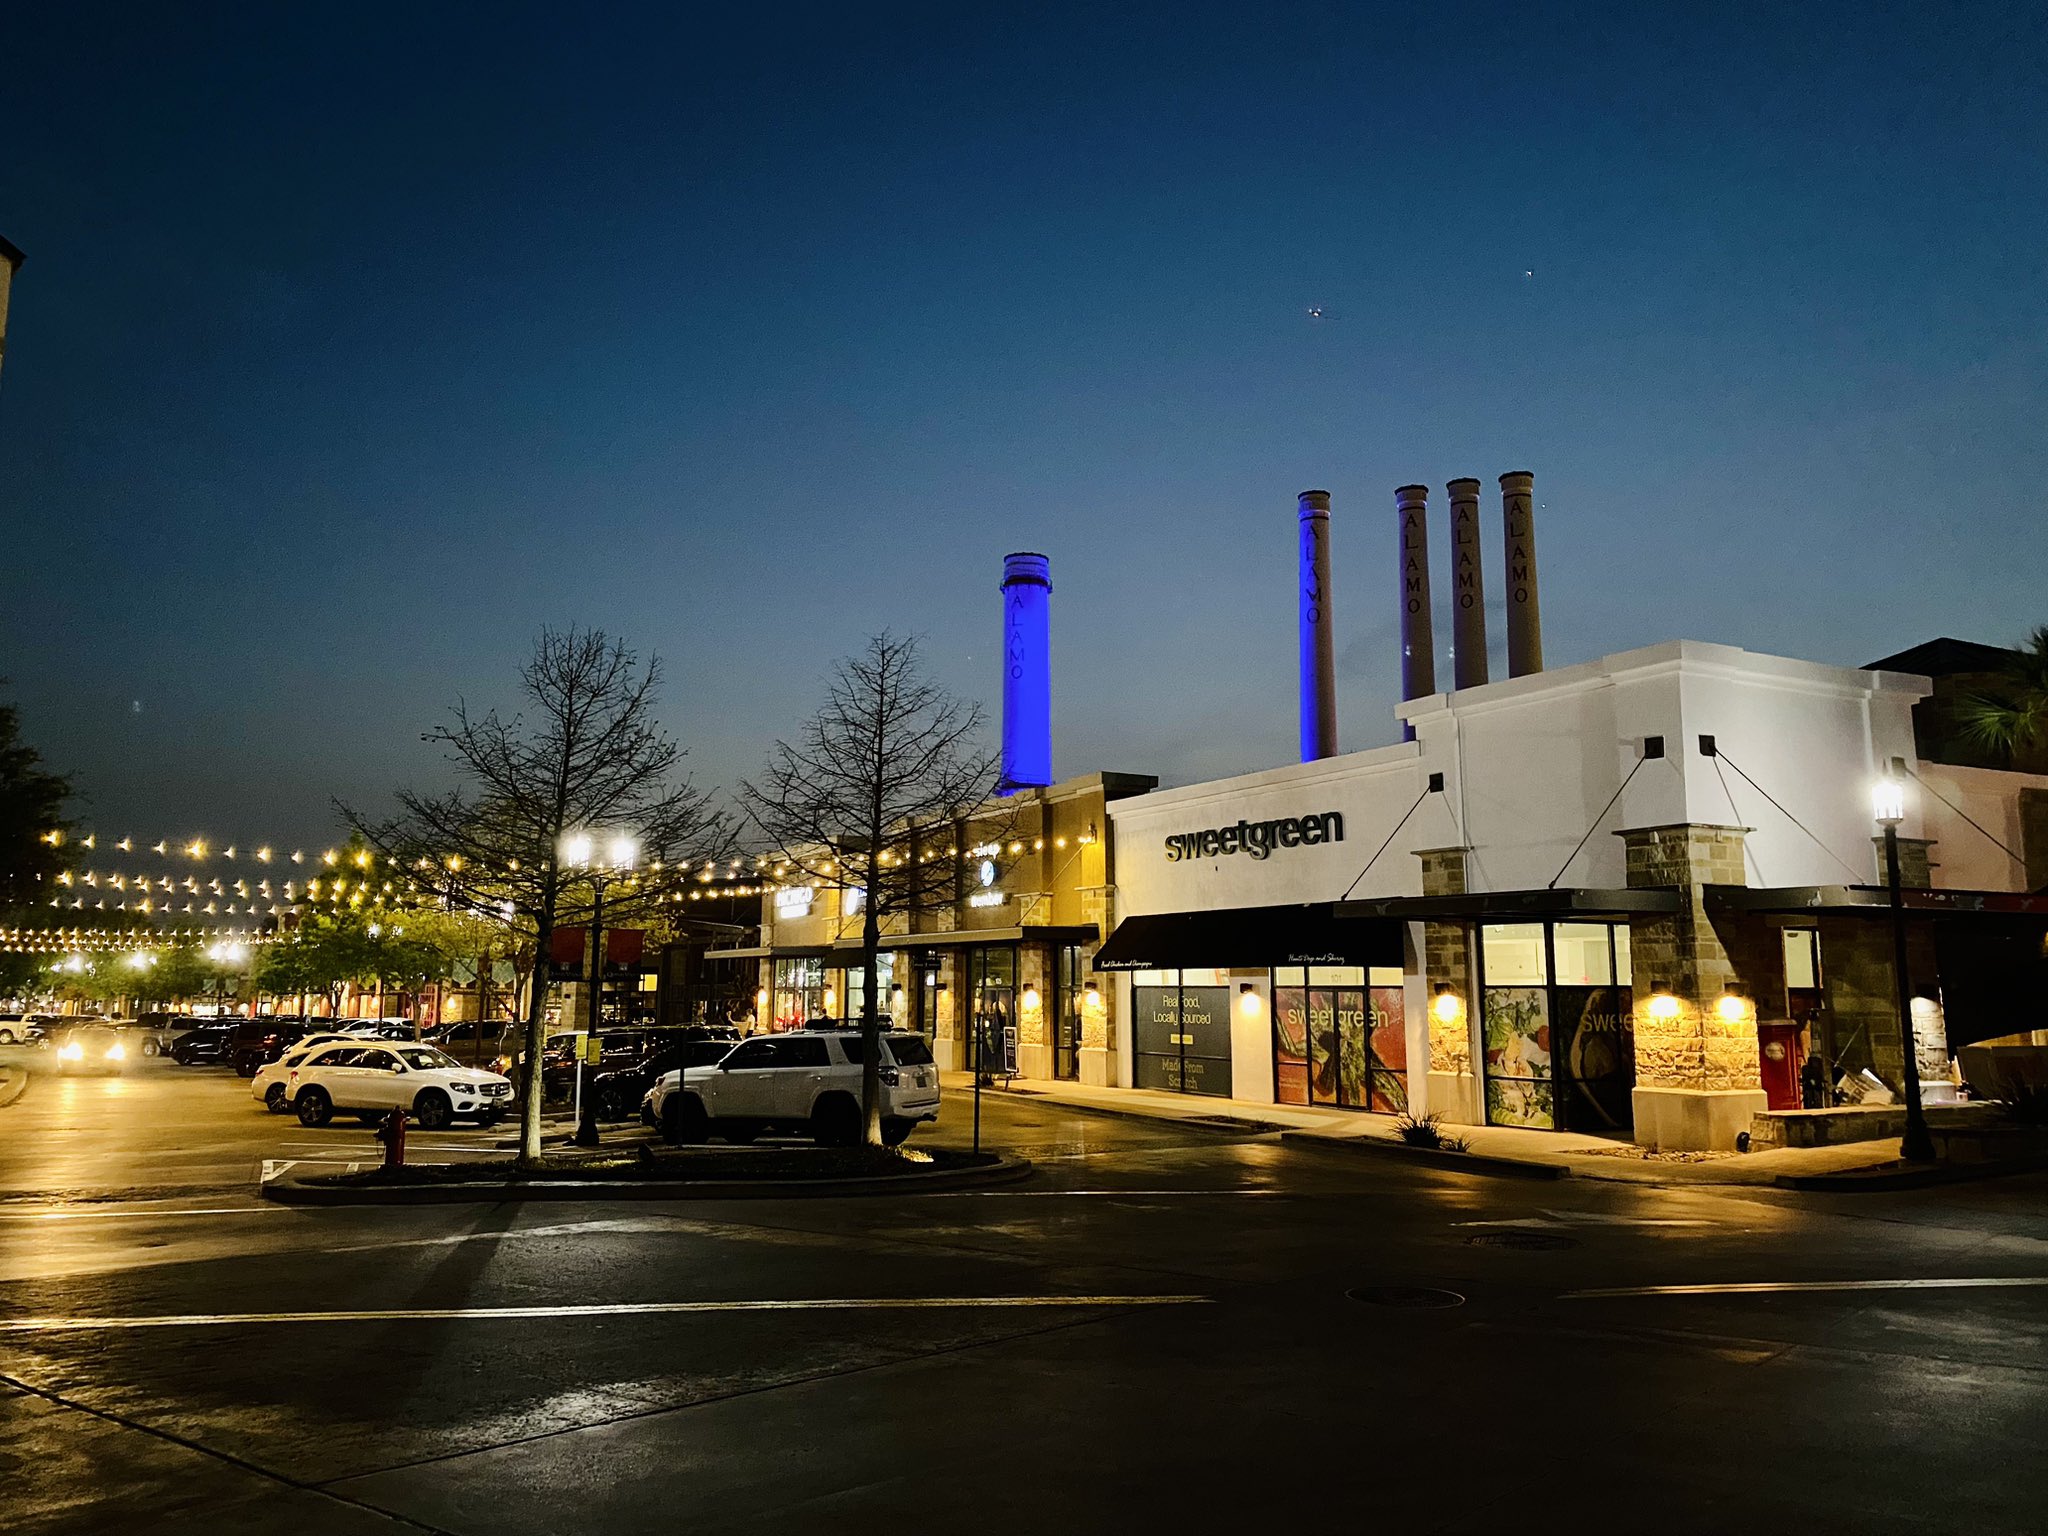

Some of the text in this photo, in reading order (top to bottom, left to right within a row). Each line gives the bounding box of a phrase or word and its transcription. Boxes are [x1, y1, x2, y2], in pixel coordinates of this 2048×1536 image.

[1305, 524, 1322, 624] ALAMO
[1405, 513, 1421, 614] ALAMO
[1456, 507, 1475, 609] ALAMO
[1510, 500, 1528, 603] ALAMO
[1009, 594, 1025, 680] ALAMO
[1165, 811, 1346, 863] sweetgreen
[1153, 1010, 1179, 1026] Locally
[1162, 994, 1201, 1009] Real ood,
[1287, 1006, 1389, 1033] sweetgreen
[1162, 1058, 1181, 1071] Mad
[1168, 1074, 1198, 1090] Scrtch
